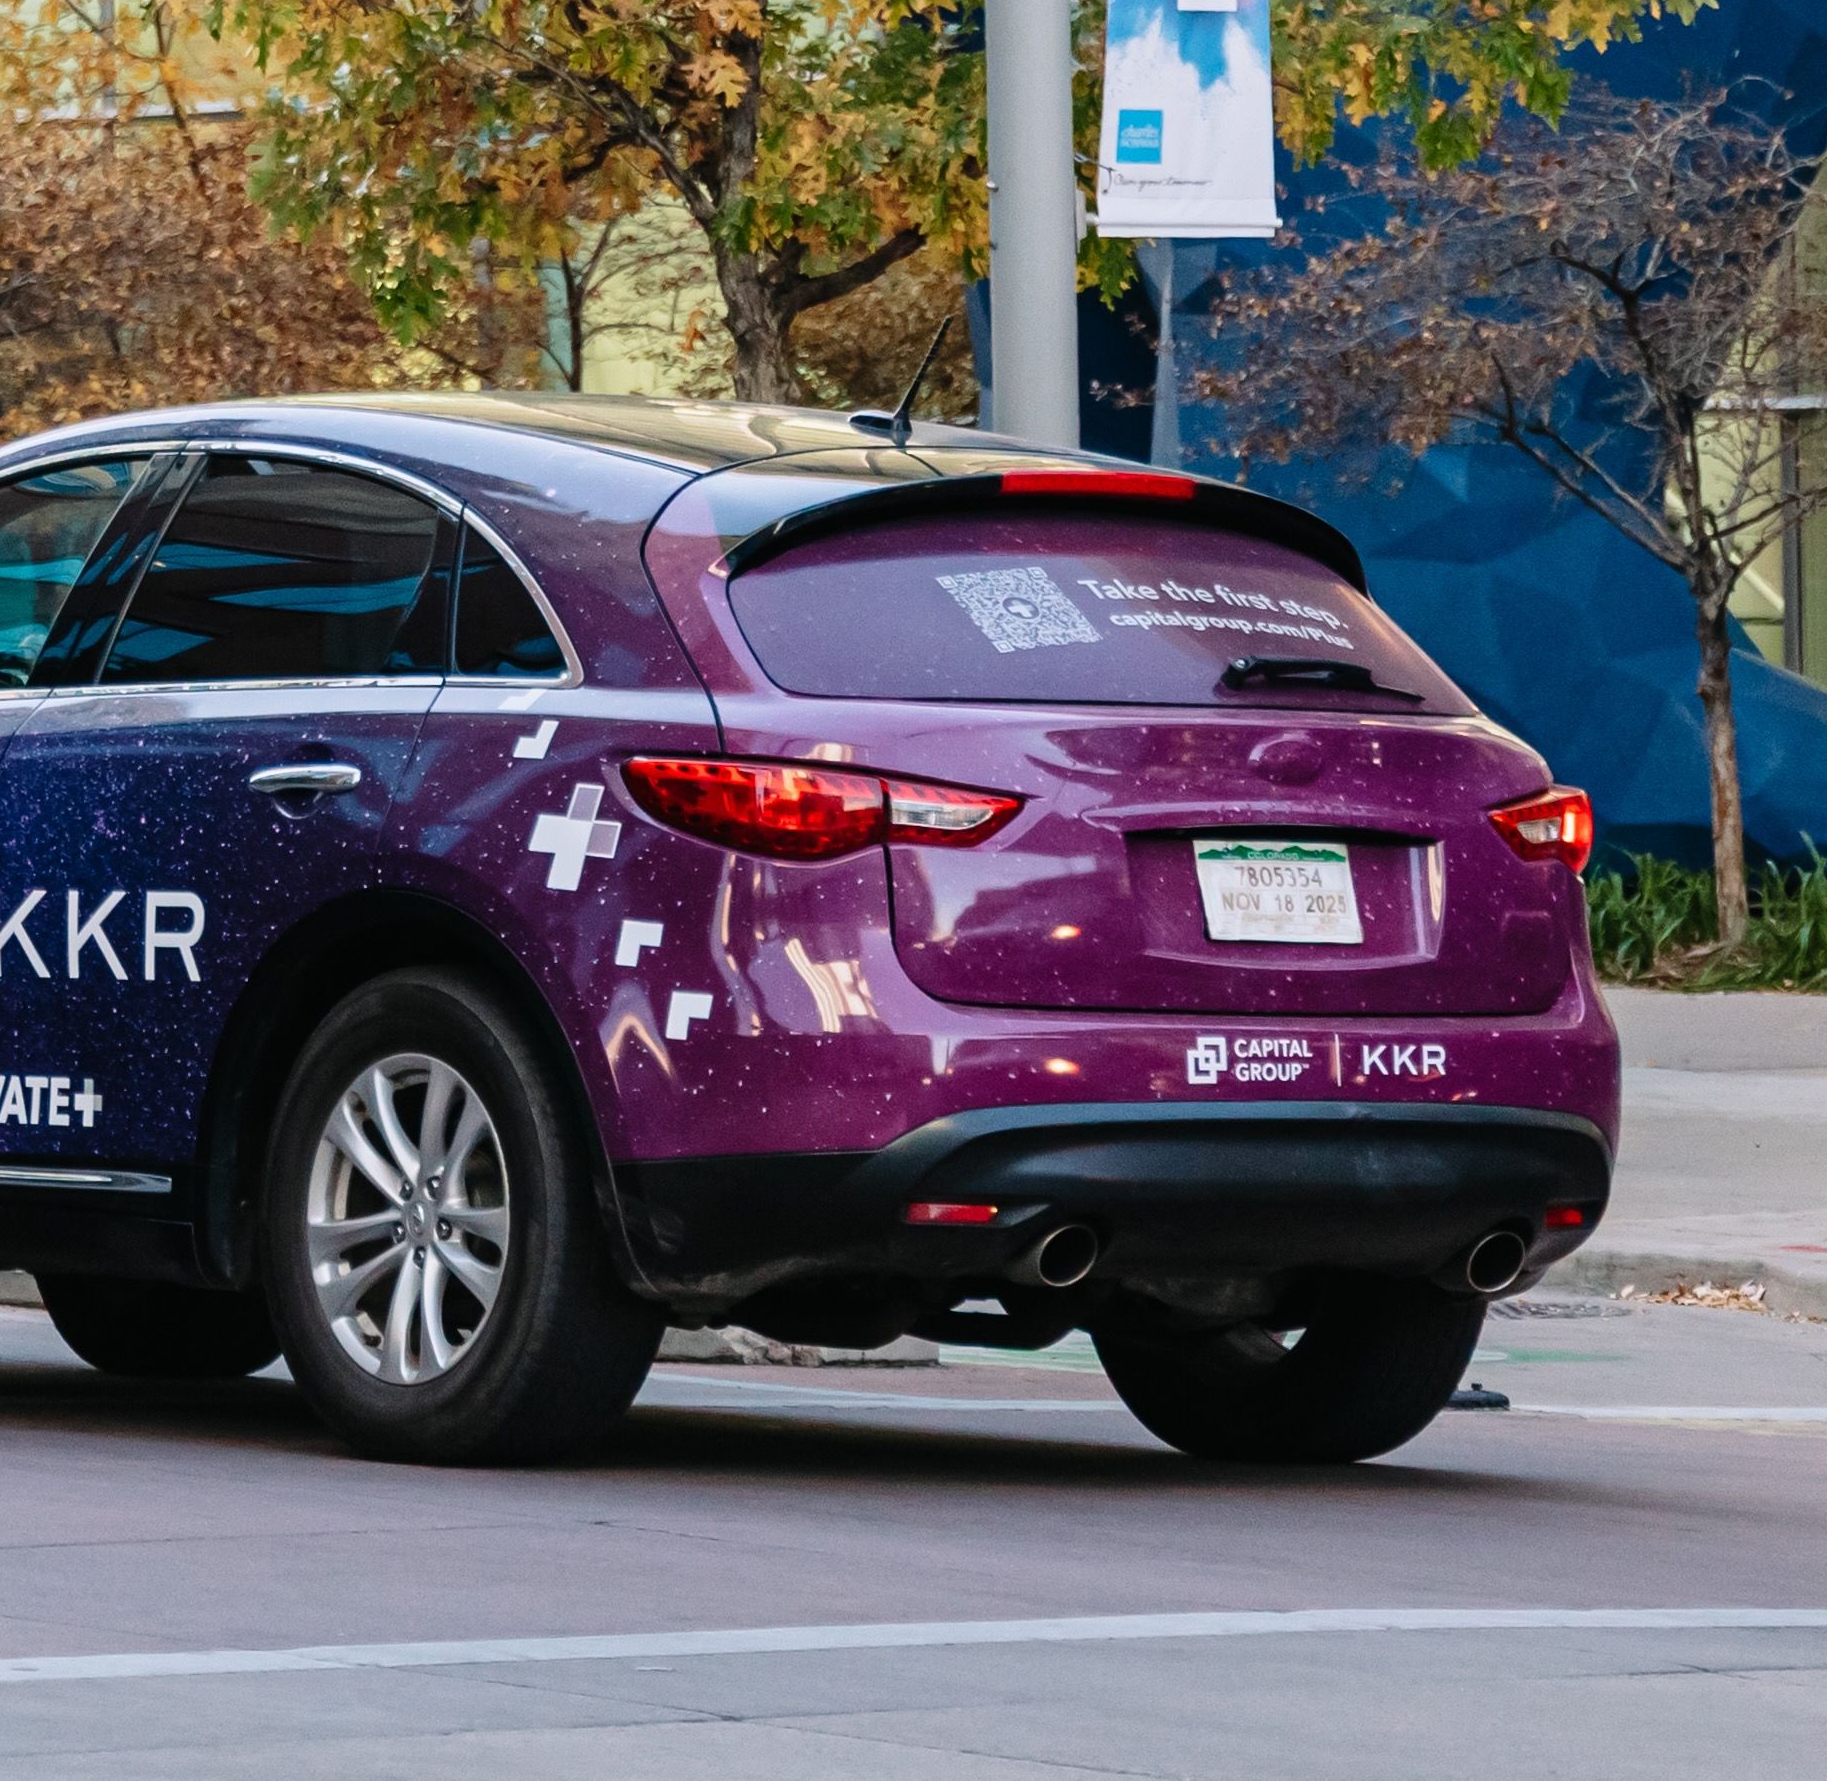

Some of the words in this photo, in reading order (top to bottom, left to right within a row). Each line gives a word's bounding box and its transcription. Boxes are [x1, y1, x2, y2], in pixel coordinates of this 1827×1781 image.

[1077, 579, 1159, 601] Take
[1160, 581, 1215, 603] the
[1215, 584, 1281, 612] first
[1279, 598, 1349, 629] step.
[1109, 610, 1355, 650] capitalgroup.com/Plus
[1221, 892, 1261, 912] NOV
[1275, 894, 1294, 912] 18
[1305, 895, 1347, 913] 2025
[1233, 1038, 1314, 1058] CAPITAL
[1362, 1044, 1447, 1076] KKR
